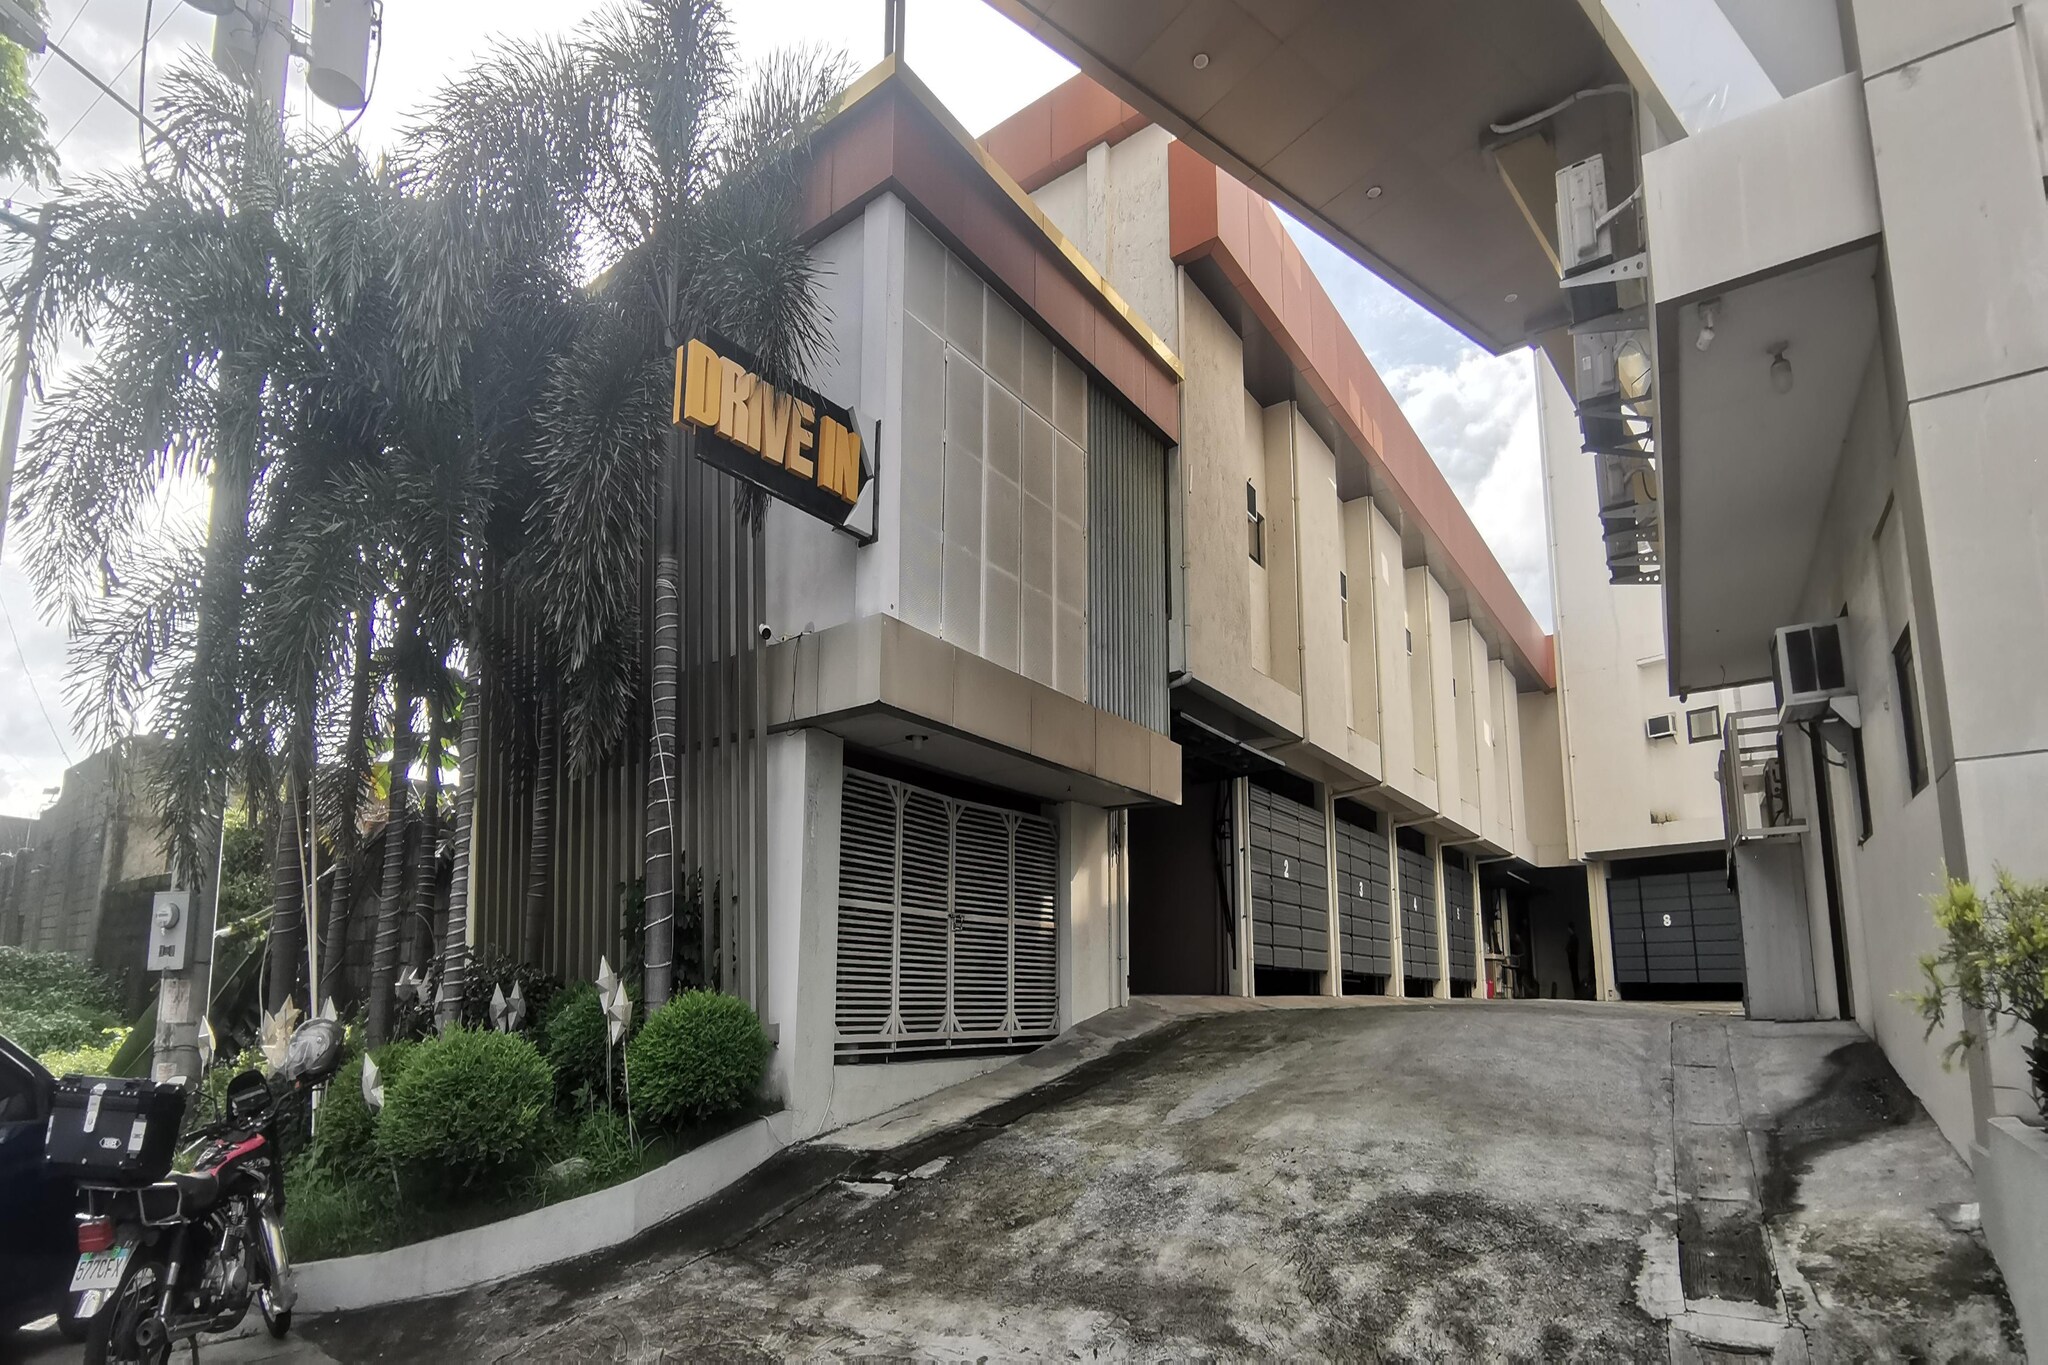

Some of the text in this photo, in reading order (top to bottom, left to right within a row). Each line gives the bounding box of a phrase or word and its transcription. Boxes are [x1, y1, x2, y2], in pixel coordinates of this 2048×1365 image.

[684, 338, 861, 504] DRIVE IN
[1283, 859, 1290, 879] 2
[1358, 881, 1364, 898] 3
[1413, 897, 1418, 912] 4
[1663, 914, 1672, 927] 8
[75, 1257, 124, 1281] 577CFX
